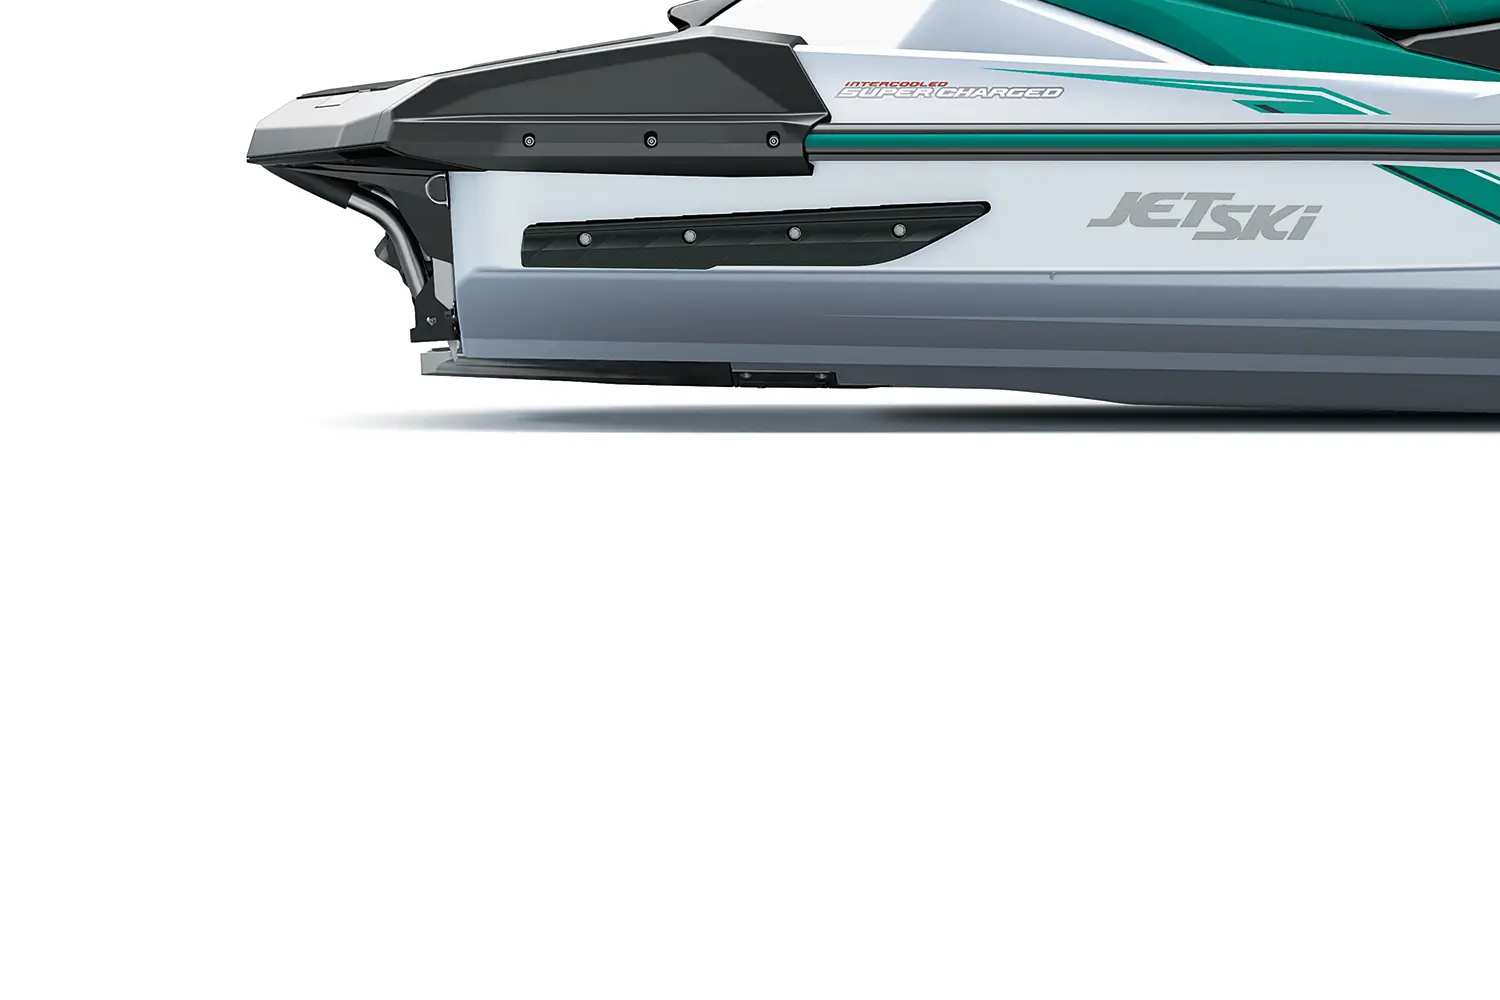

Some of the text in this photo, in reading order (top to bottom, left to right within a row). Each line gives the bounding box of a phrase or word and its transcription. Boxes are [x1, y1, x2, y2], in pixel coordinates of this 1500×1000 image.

[844, 80, 949, 88] INTERCOOLED
[836, 86, 1066, 99] SUPER CHARGED
[1086, 191, 1236, 228] JET
